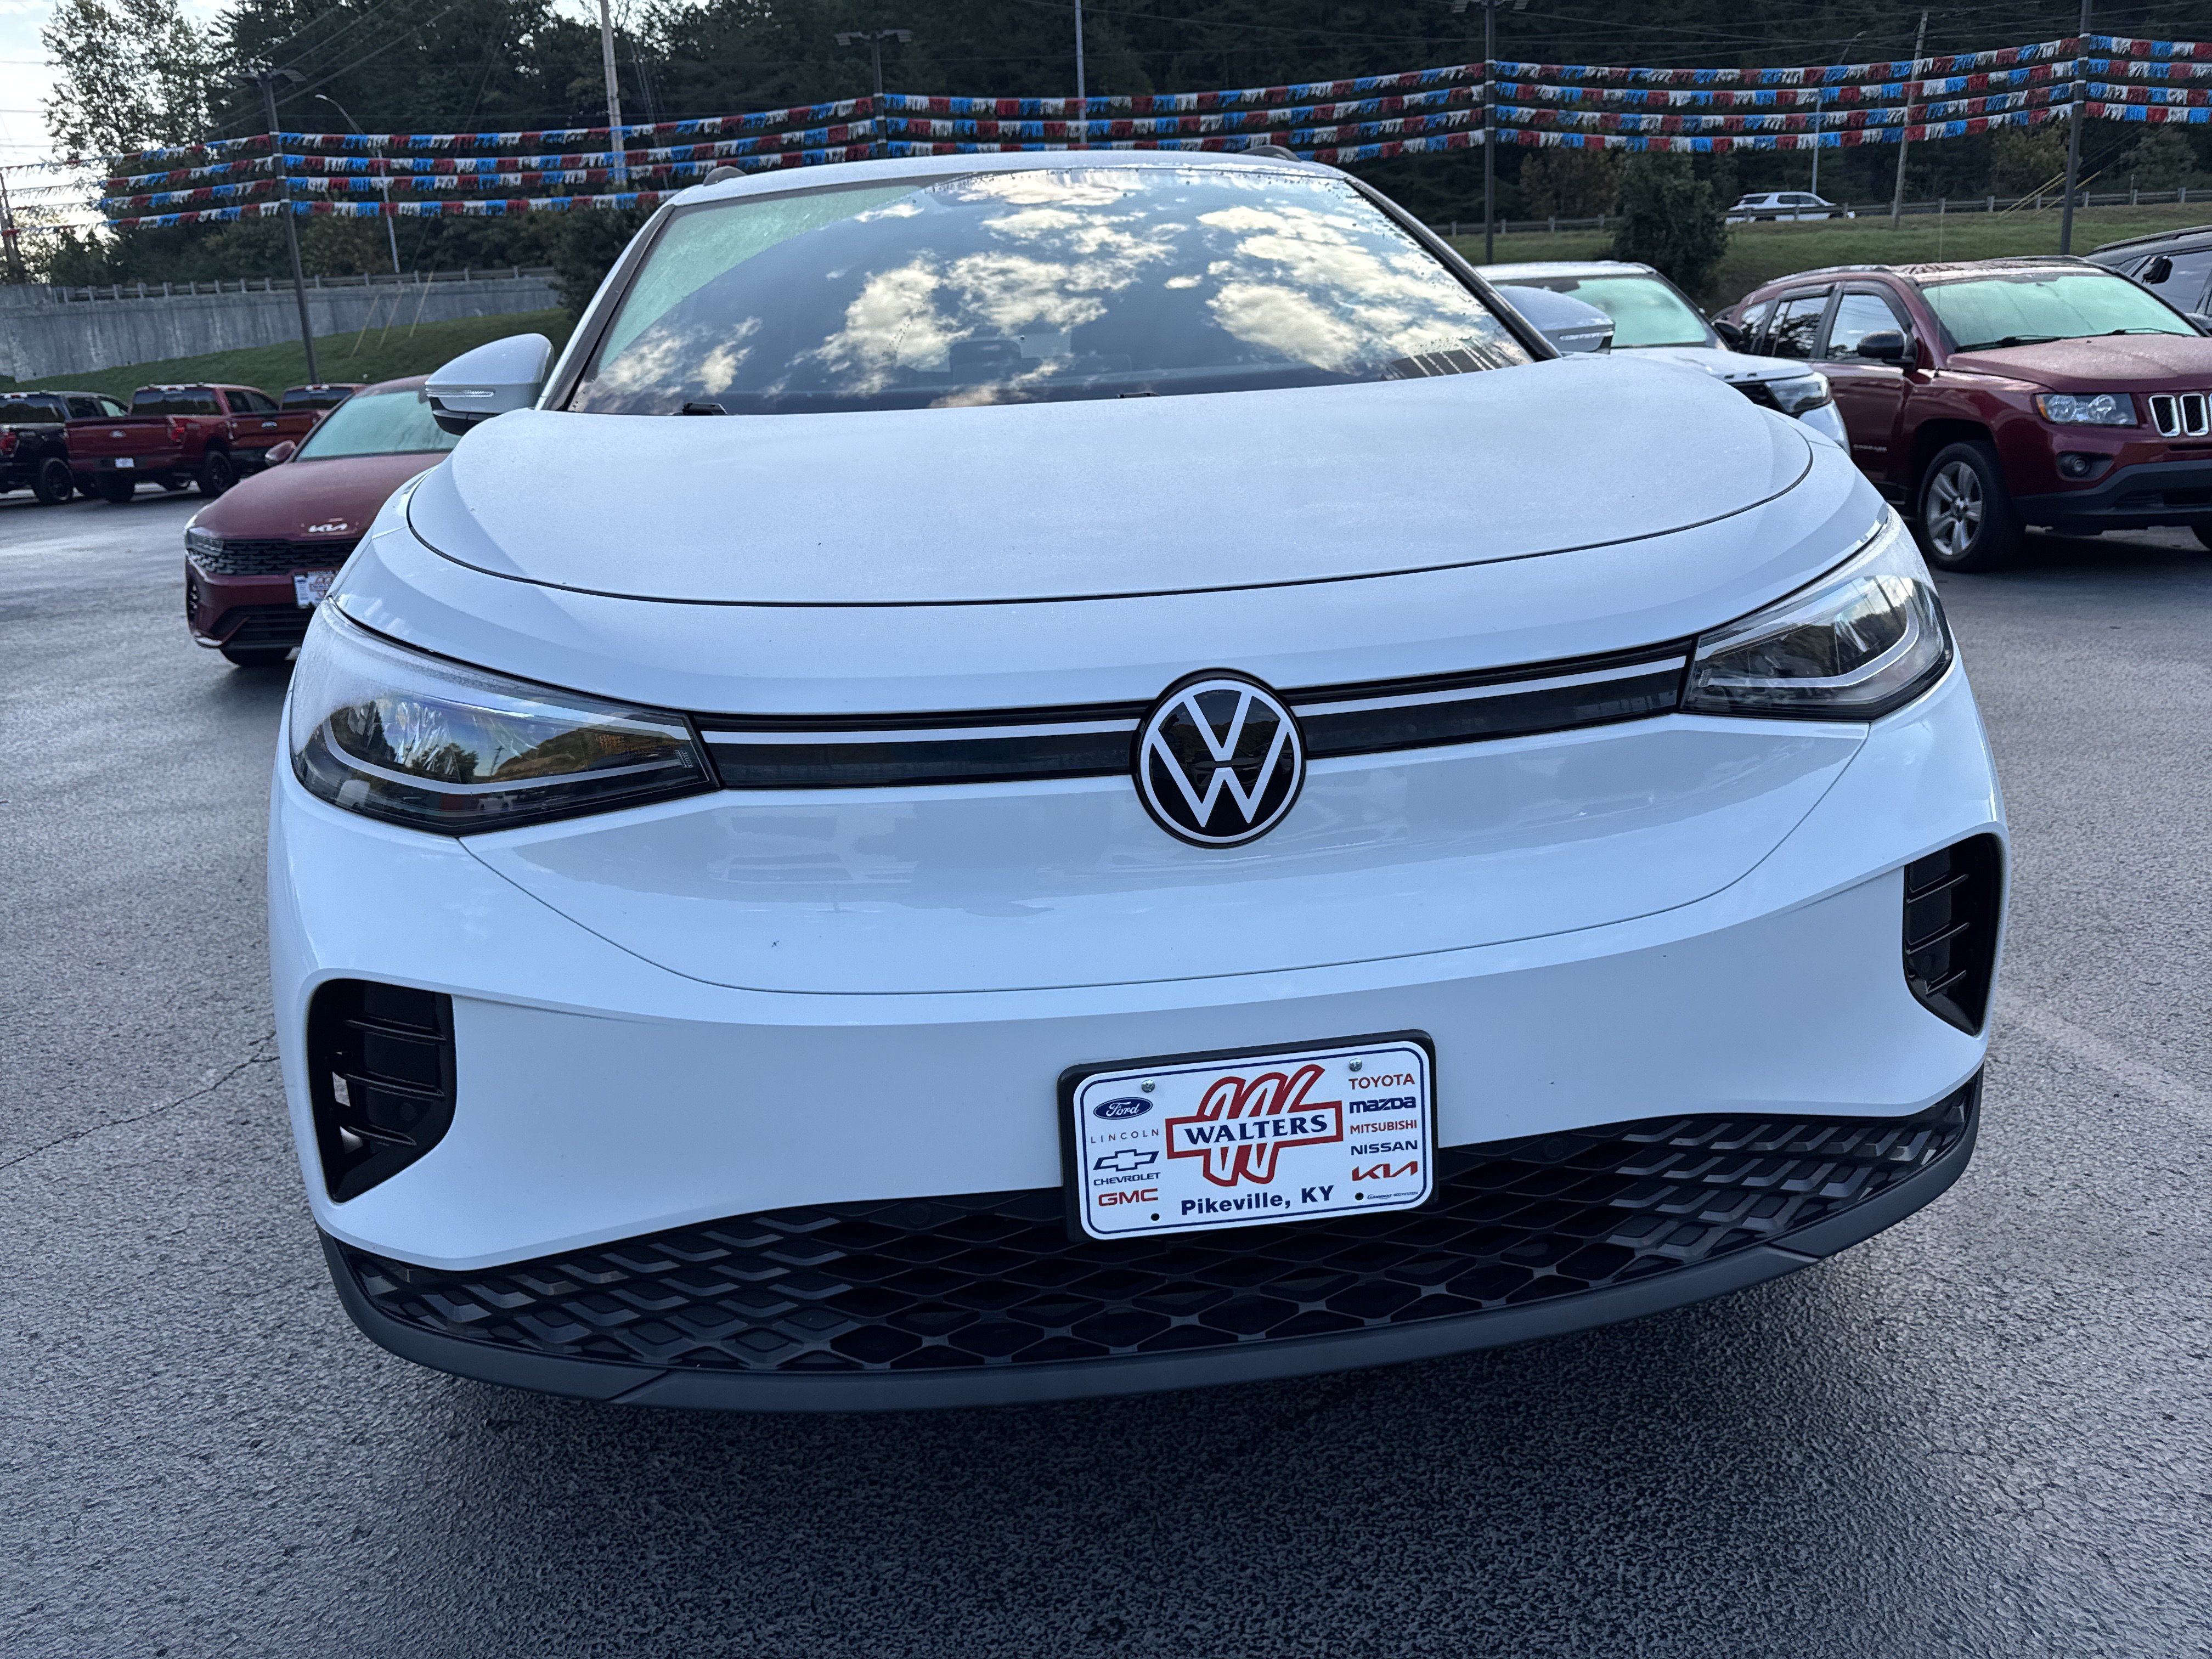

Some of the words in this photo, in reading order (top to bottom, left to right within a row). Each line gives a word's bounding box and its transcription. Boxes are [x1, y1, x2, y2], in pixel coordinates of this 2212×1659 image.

[1348, 1074, 1415, 1090] TOYOTA
[1106, 1102, 1140, 1116] Ford
[1184, 1115, 1327, 1144] WALTERS
[1350, 1120, 1417, 1134] MITSUBISHI
[1091, 1128, 1159, 1143] LINCOLN
[1351, 1140, 1418, 1155] NISSAN
[1352, 1161, 1418, 1181] KIA
[1093, 1172, 1161, 1186] CHEVROLET
[1098, 1188, 1158, 1206] GMC
[1181, 1192, 1290, 1215] Pikeville,
[1301, 1185, 1334, 1204] KY
